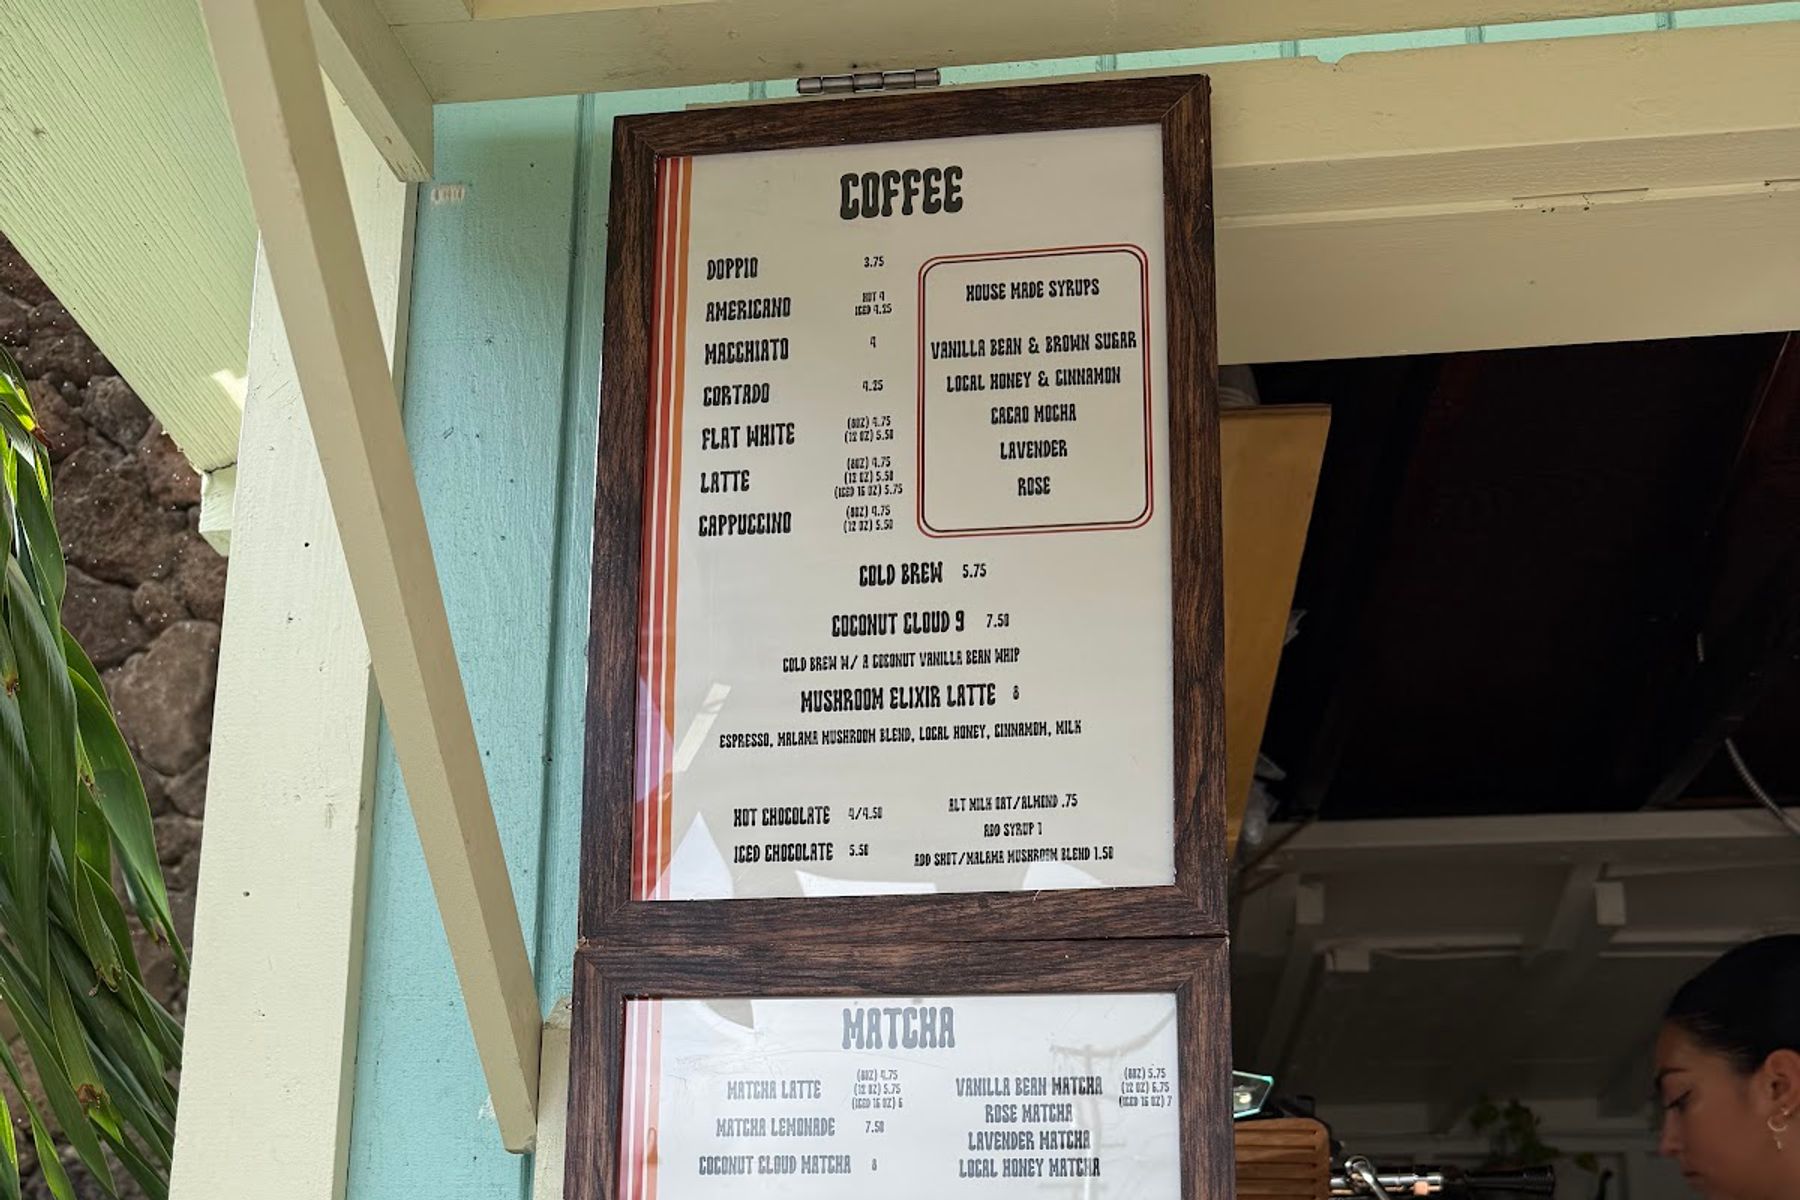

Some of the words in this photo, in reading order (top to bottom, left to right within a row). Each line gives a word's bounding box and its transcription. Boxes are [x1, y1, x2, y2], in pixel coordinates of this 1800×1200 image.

[840, 166, 963, 221] COFFEE
[706, 257, 758, 281] DOPPIO
[966, 282, 1006, 302] HOUSE
[1010, 280, 1044, 300] MADE
[1048, 278, 1100, 298] SYRUPS
[706, 297, 791, 322] AMERICANO
[705, 338, 789, 365] MACCHIATO
[931, 339, 986, 360] VANILLA
[990, 337, 1022, 357] BEAN
[1028, 337, 1040, 354] &
[1045, 333, 1090, 354] BROWN
[1095, 331, 1137, 350] SUGAR
[947, 374, 985, 393] LOCAL
[990, 371, 1032, 390] HONEY
[1038, 370, 1050, 387] &
[1055, 366, 1121, 387] CINNAMON
[703, 382, 770, 407] CORTADO
[991, 406, 1029, 425] CACAO
[1034, 403, 1077, 423] MOCHA
[702, 426, 741, 451] FLAT
[746, 422, 795, 448] WHITE
[1000, 439, 1068, 460] LAVENDER
[700, 469, 750, 494] LATTE
[1018, 476, 1051, 497] ROSE
[698, 511, 792, 537] CAPPUCCINO
[859, 564, 896, 587] COLD
[901, 561, 943, 585] BREW
[832, 612, 898, 637] COCONUT
[903, 610, 950, 635] CLOUD
[955, 610, 965, 632] 9
[783, 657, 807, 673] COLD
[810, 655, 837, 672] BREW
[919, 650, 963, 667] VANILLA
[966, 649, 991, 665] BEAN
[995, 647, 1020, 663] WHIP
[801, 687, 884, 713] MUSHROOM
[889, 685, 941, 710] ELIXIR
[947, 683, 996, 707] LATTE
[719, 732, 774, 748] ESPRESSO,
[919, 726, 950, 741] LOCAL
[953, 724, 990, 740] HONEY,
[734, 808, 758, 827] HOT
[762, 805, 830, 826] CHOCOLATE
[734, 844, 761, 863] ICED
[765, 842, 834, 863] CHOCOLATE
[842, 1006, 956, 1050] MATCHA
[727, 1080, 777, 1100] MATCHA
[782, 1080, 821, 1099] LATTE
[955, 1077, 1011, 1097] VANILLA
[1015, 1077, 1047, 1096] BEAN
[1052, 1076, 1103, 1096] MATCHA
[985, 1104, 1018, 1123] ROSE
[1022, 1103, 1073, 1123] MATCHA
[716, 1117, 766, 1137] MATCHA
[771, 1117, 835, 1137] LEMONADE
[968, 1131, 1035, 1151] LAVENDER
[1039, 1130, 1090, 1150] MATCHA
[699, 1155, 754, 1175] COCONUT
[758, 1155, 797, 1175] CLOUD
[801, 1155, 852, 1174] MATCHA
[959, 1158, 998, 1178] LOCAL
[1002, 1158, 1044, 1178] HONEY
[1049, 1157, 1101, 1177] MATCHA
